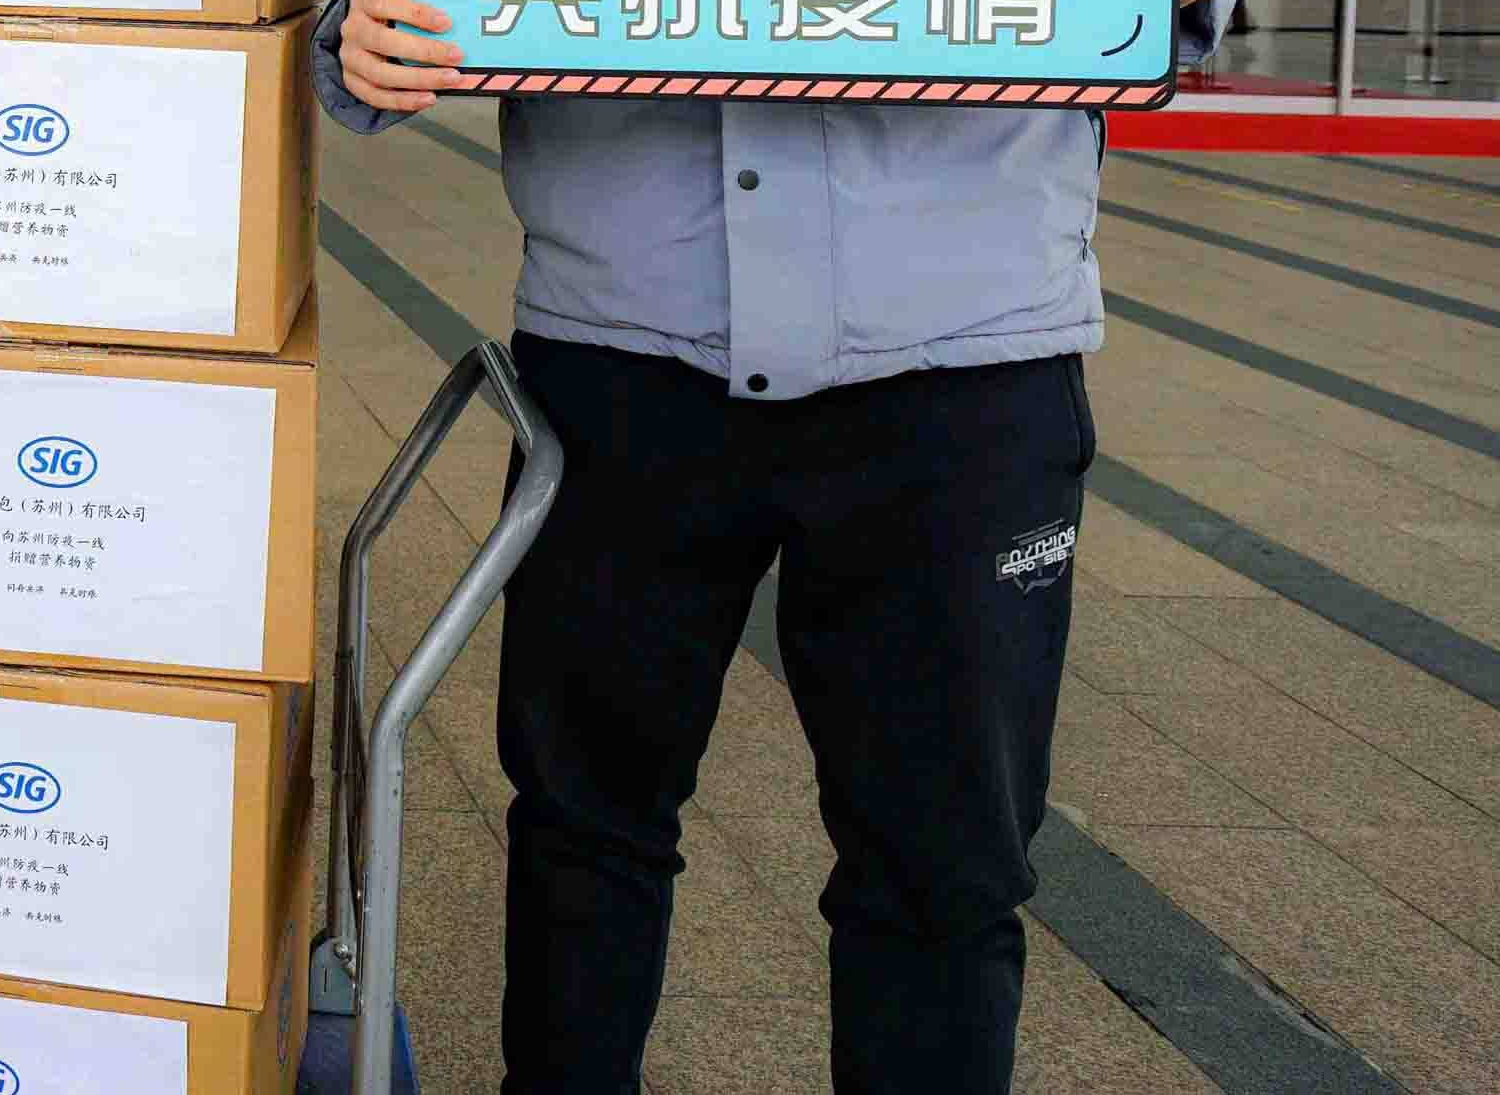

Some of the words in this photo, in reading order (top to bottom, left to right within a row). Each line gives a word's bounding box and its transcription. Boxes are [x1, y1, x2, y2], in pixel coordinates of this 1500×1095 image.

[2, 113, 56, 144] SIG
[29, 446, 85, 477] SIG
[1, 529, 105, 551] 向苏州防疫一线
